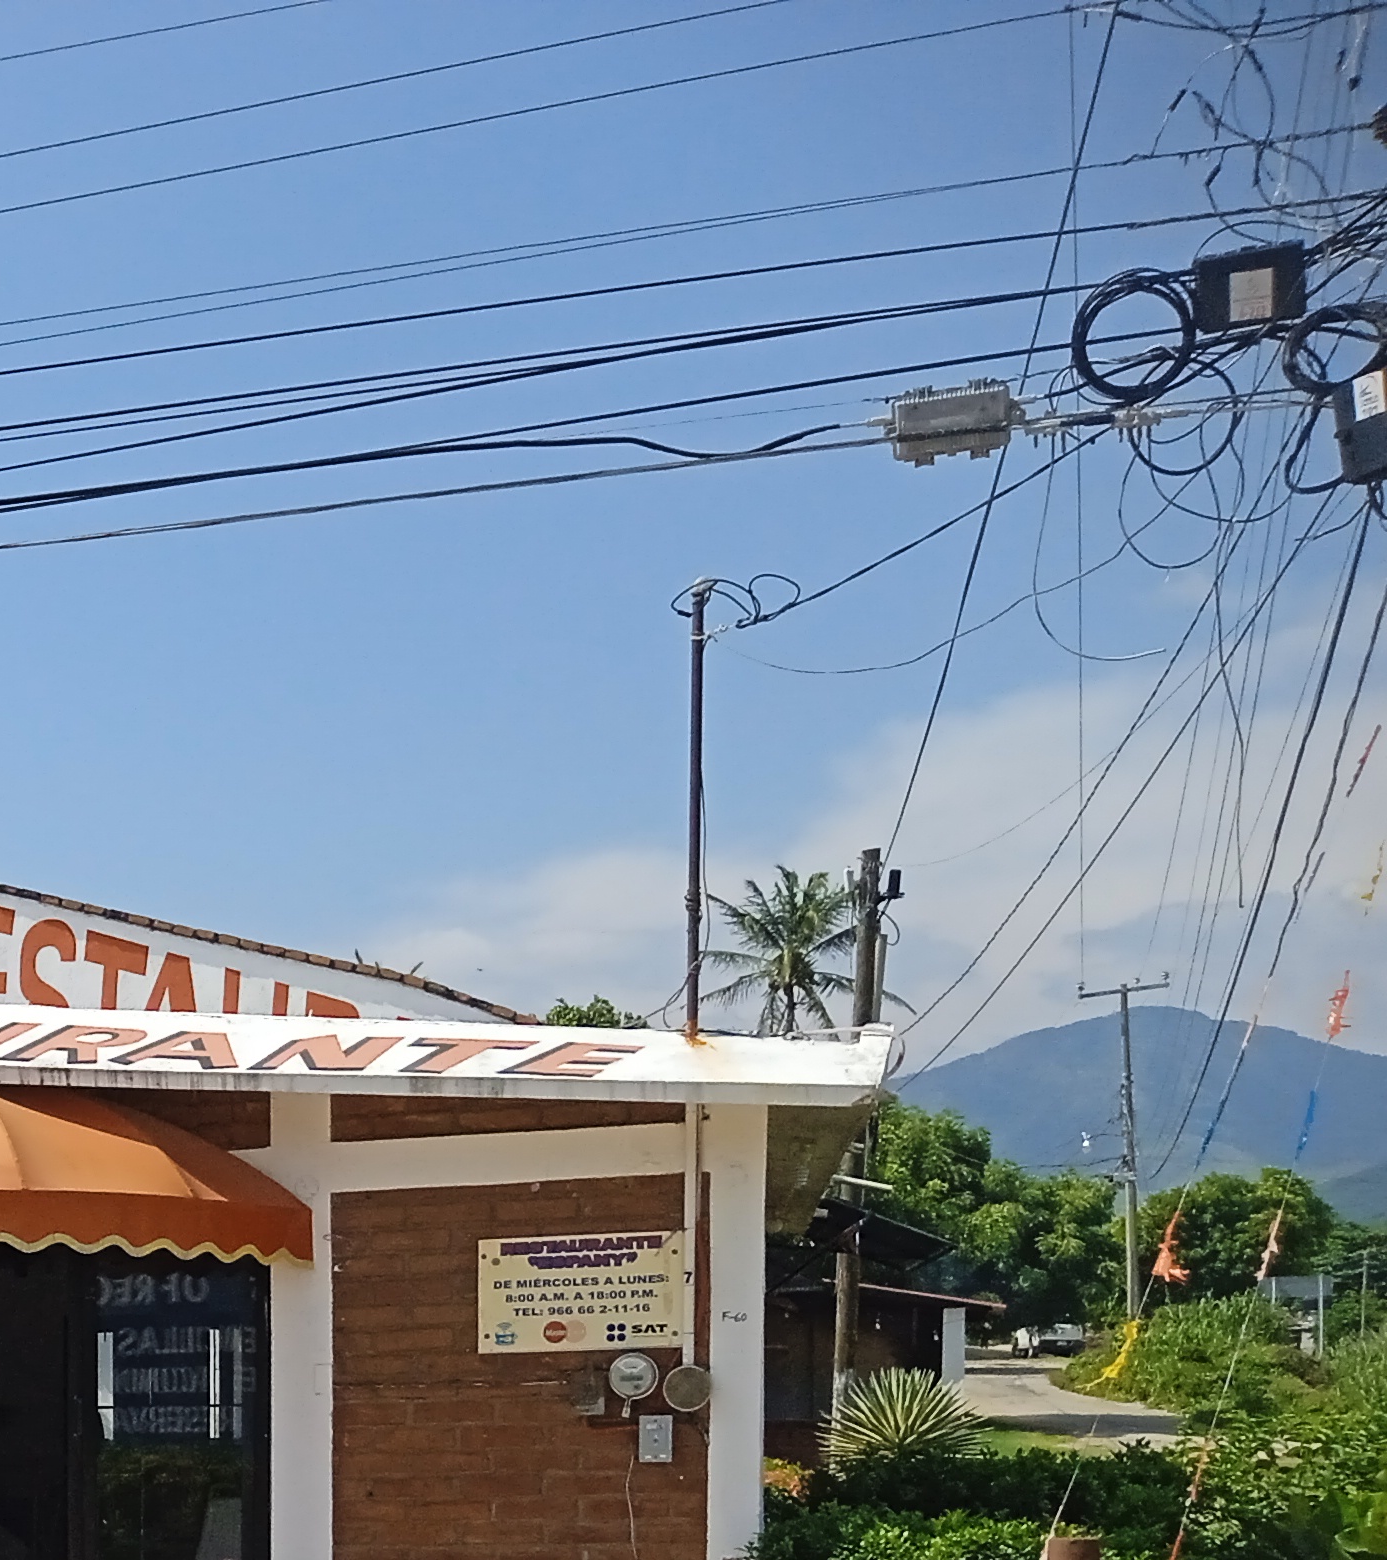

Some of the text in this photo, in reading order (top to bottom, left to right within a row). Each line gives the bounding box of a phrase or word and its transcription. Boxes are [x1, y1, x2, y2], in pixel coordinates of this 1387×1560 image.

[500, 1235, 663, 1256] RESTAURANTE
[493, 1273, 669, 1290] DE MIÉRCOLES A LUNES:
[683, 1271, 694, 1284] 7
[505, 1288, 659, 1304] 8:00 A.M. A 18:00 P.M.
[513, 1303, 651, 1317] TEL: 966 66 2-11-16
[631, 1323, 668, 1334] SAT
